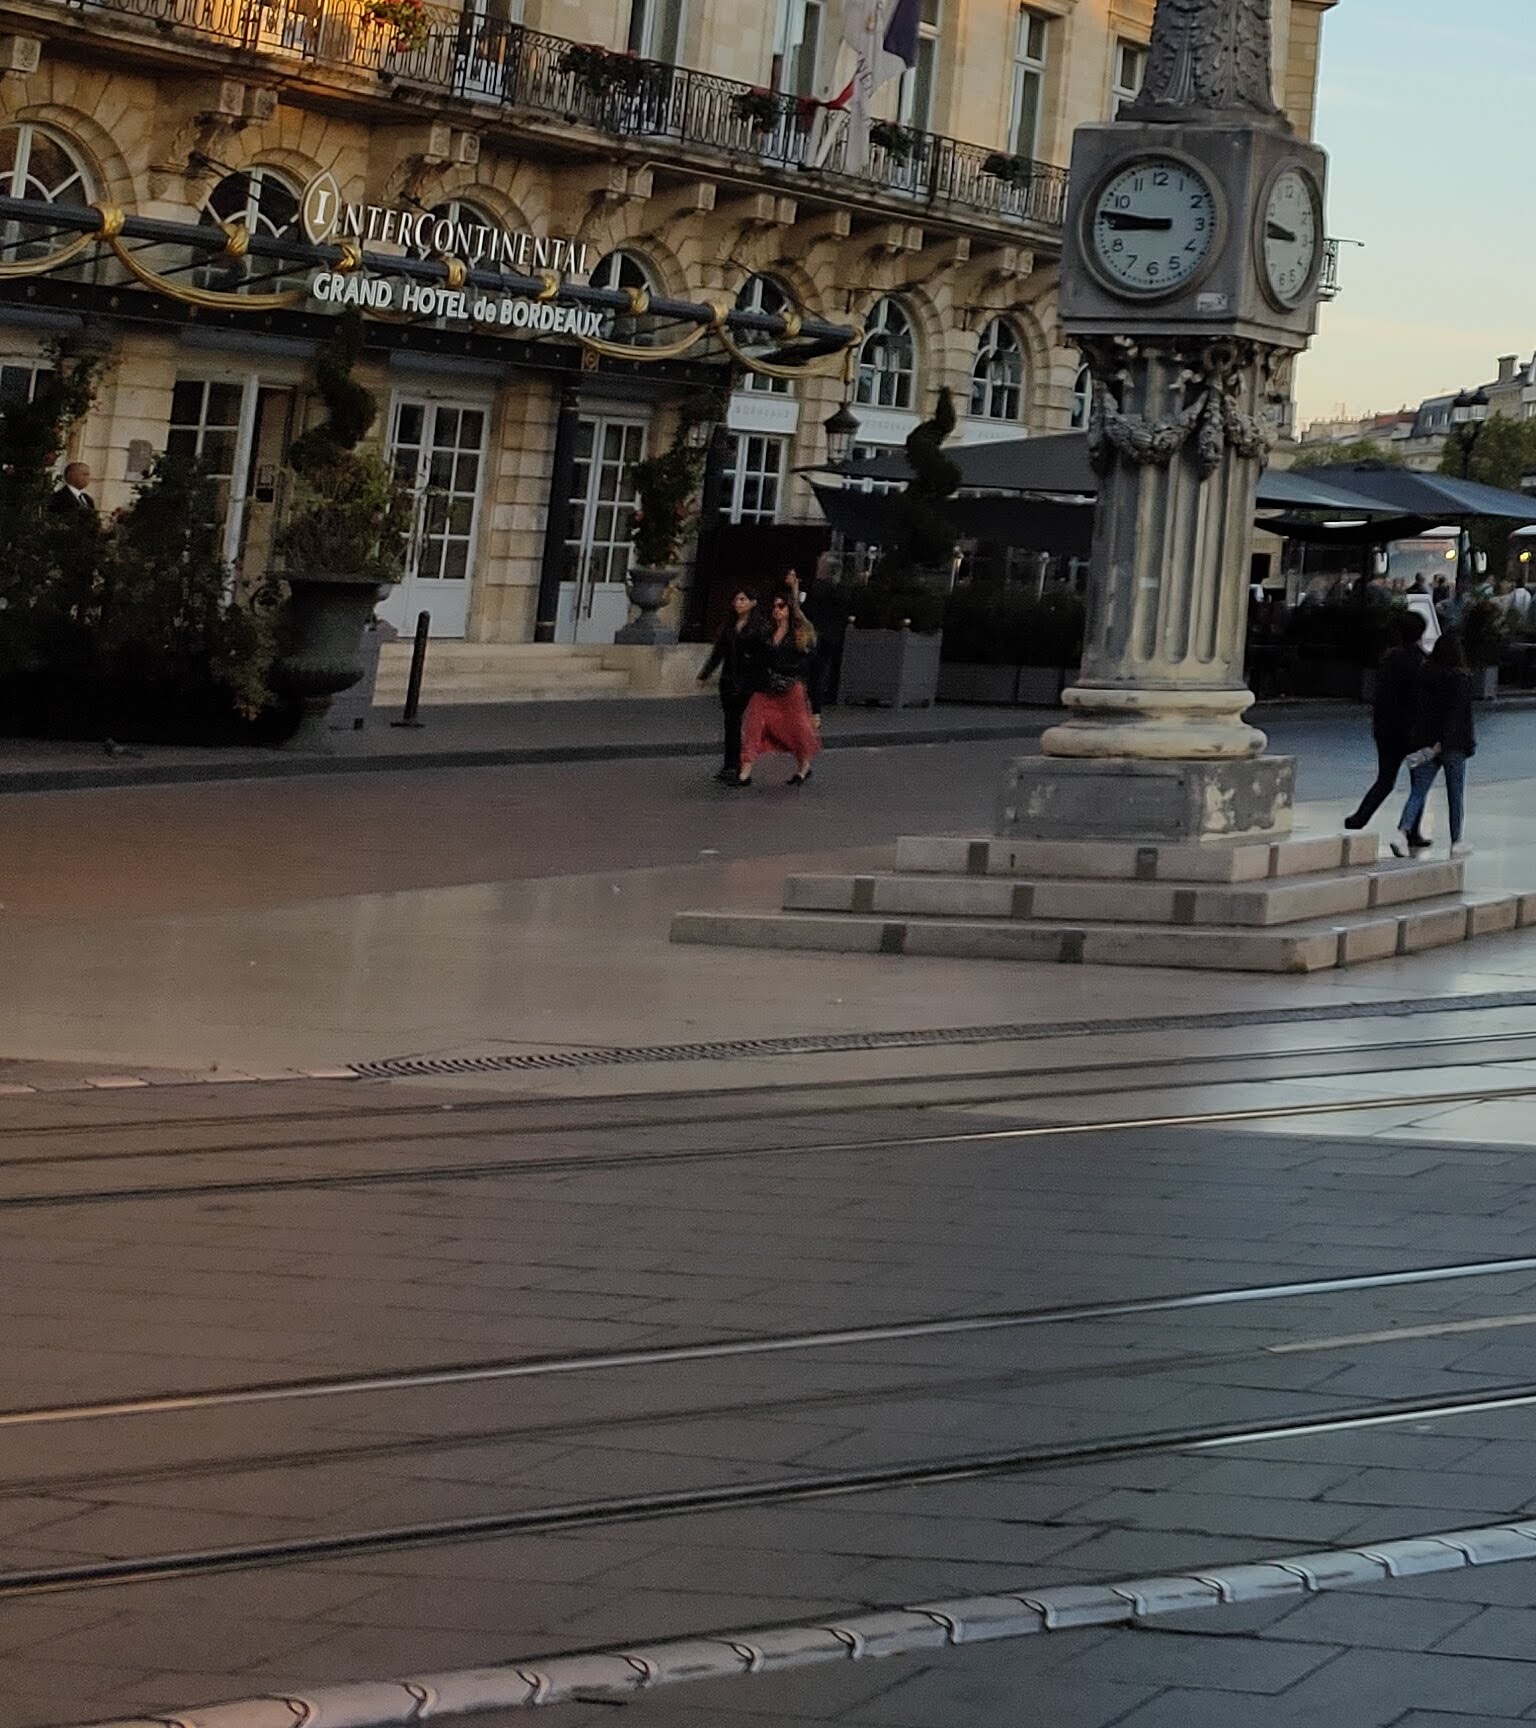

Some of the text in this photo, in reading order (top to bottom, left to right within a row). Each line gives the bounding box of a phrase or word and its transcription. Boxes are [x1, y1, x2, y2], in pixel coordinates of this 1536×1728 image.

[1134, 177, 1143, 192] 11
[1153, 172, 1169, 186] 12
[1114, 195, 1131, 209] 10
[1190, 194, 1203, 209] 2
[1194, 217, 1206, 232] 3
[1112, 238, 1125, 253] 8
[1184, 238, 1197, 252] 4
[1126, 254, 1138, 270] 7
[1146, 261, 1160, 276] 6
[1168, 256, 1181, 270] 5
[313, 272, 603, 338] GRAND HOTEL de BORDEAUX
